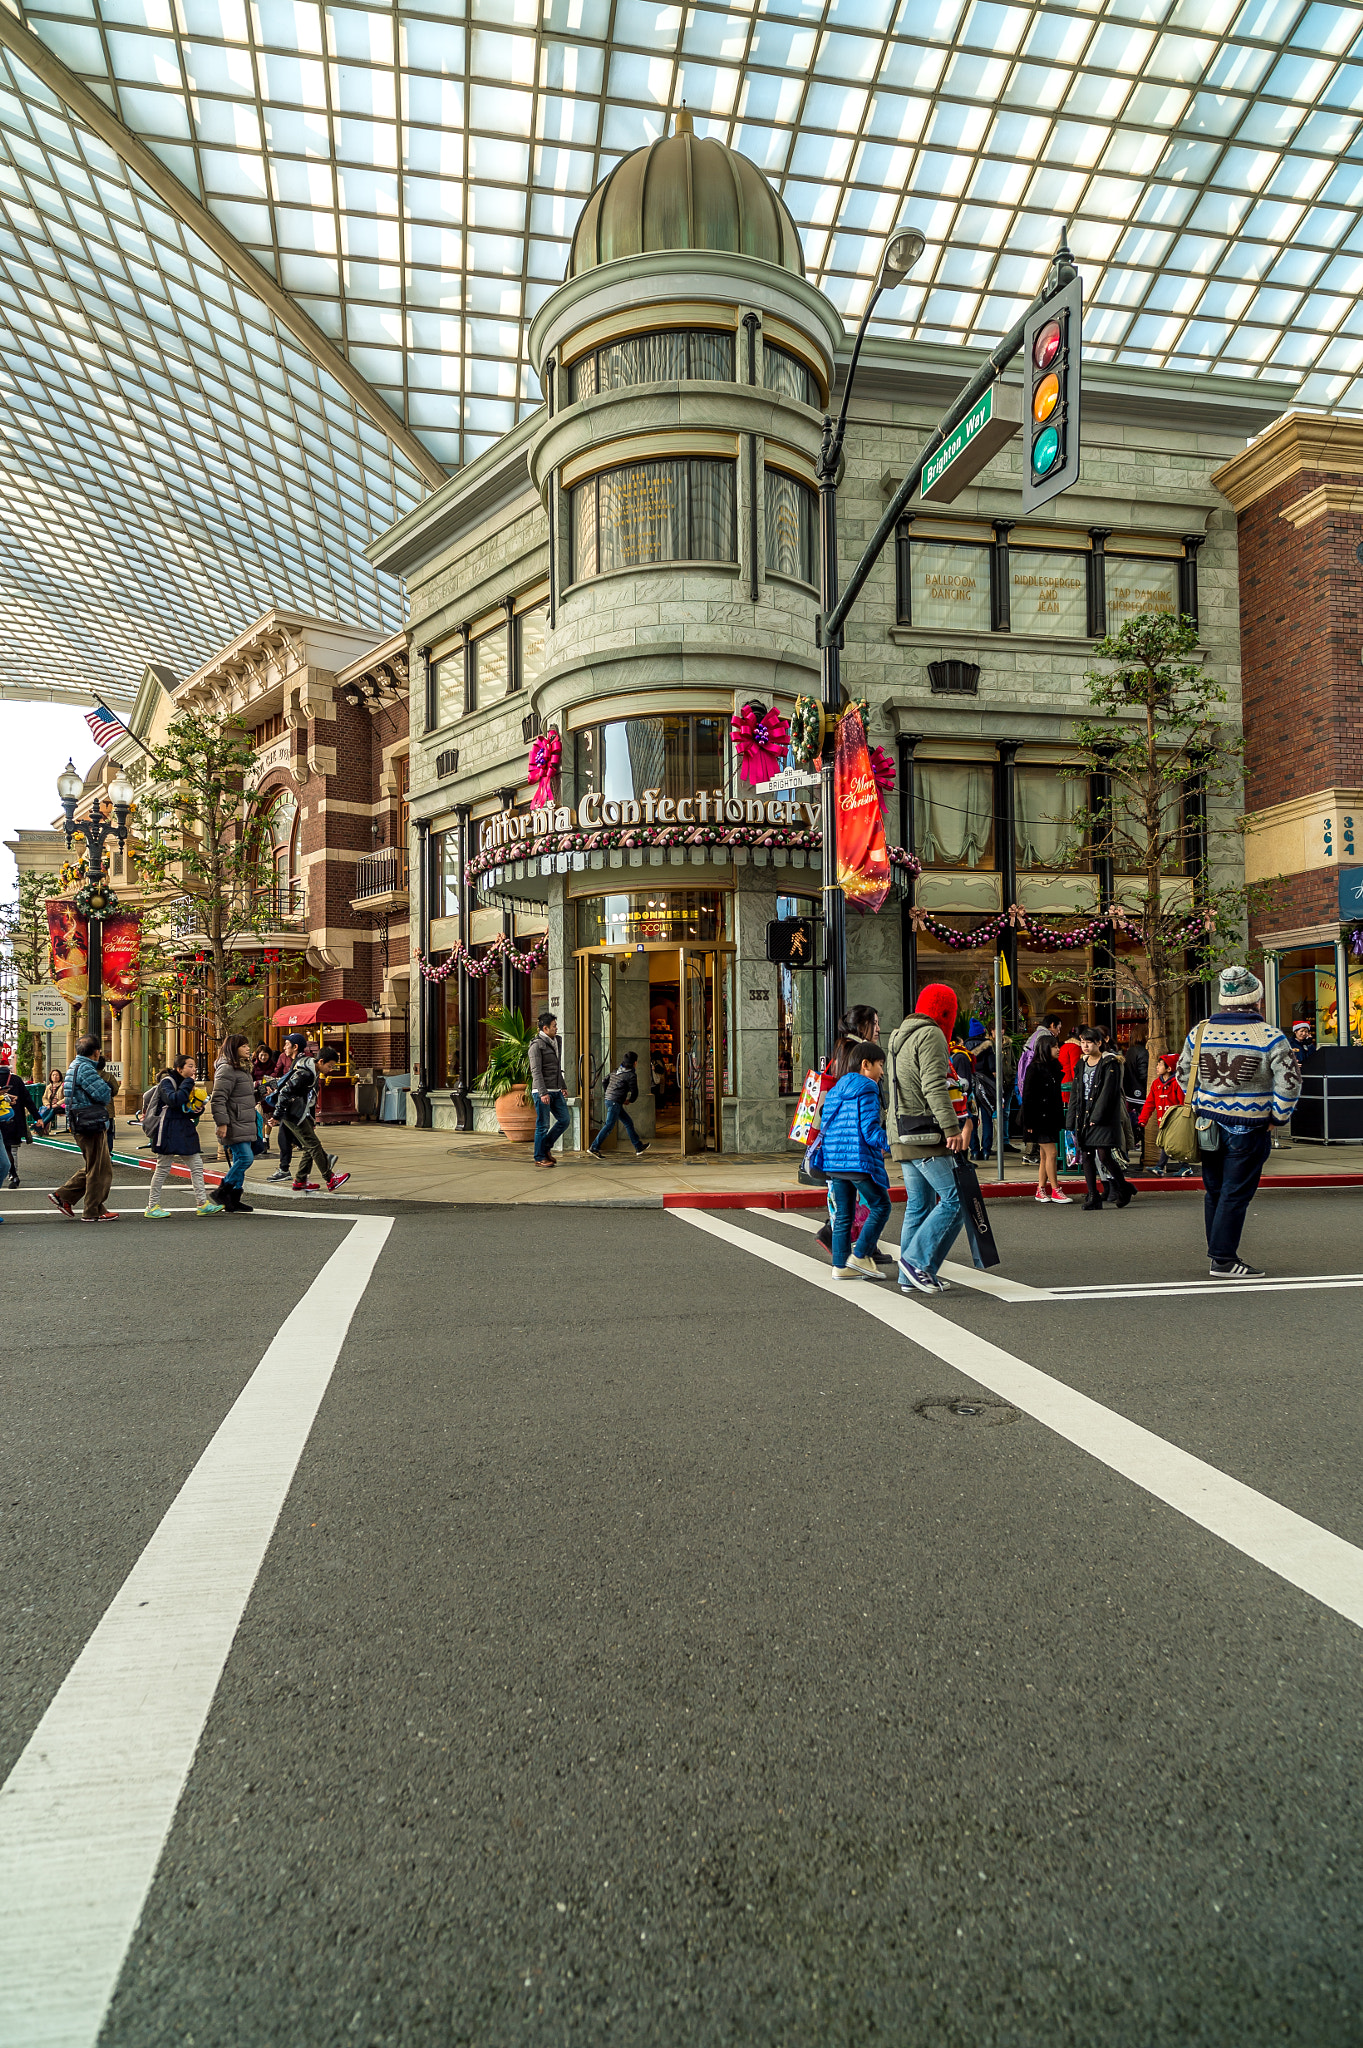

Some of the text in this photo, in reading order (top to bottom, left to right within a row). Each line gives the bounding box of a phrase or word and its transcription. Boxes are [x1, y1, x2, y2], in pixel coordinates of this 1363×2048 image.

[927, 406, 986, 484] Brighton Way
[925, 574, 976, 588] BALLROOM
[1014, 575, 1081, 590] RIDDLESPERGER
[931, 588, 971, 601] DANCING
[1038, 589, 1058, 600] AND
[1114, 588, 1172, 602] TAP DANCING
[1037, 601, 1060, 613] JEAN
[1108, 600, 1177, 615] CHOREOGRAPHY
[768, 777, 803, 791] BRIGHTON
[849, 773, 876, 796] Merry
[479, 788, 822, 852] California Confectionery
[597, 915, 609, 924] LA
[112, 935, 138, 948] Merry
